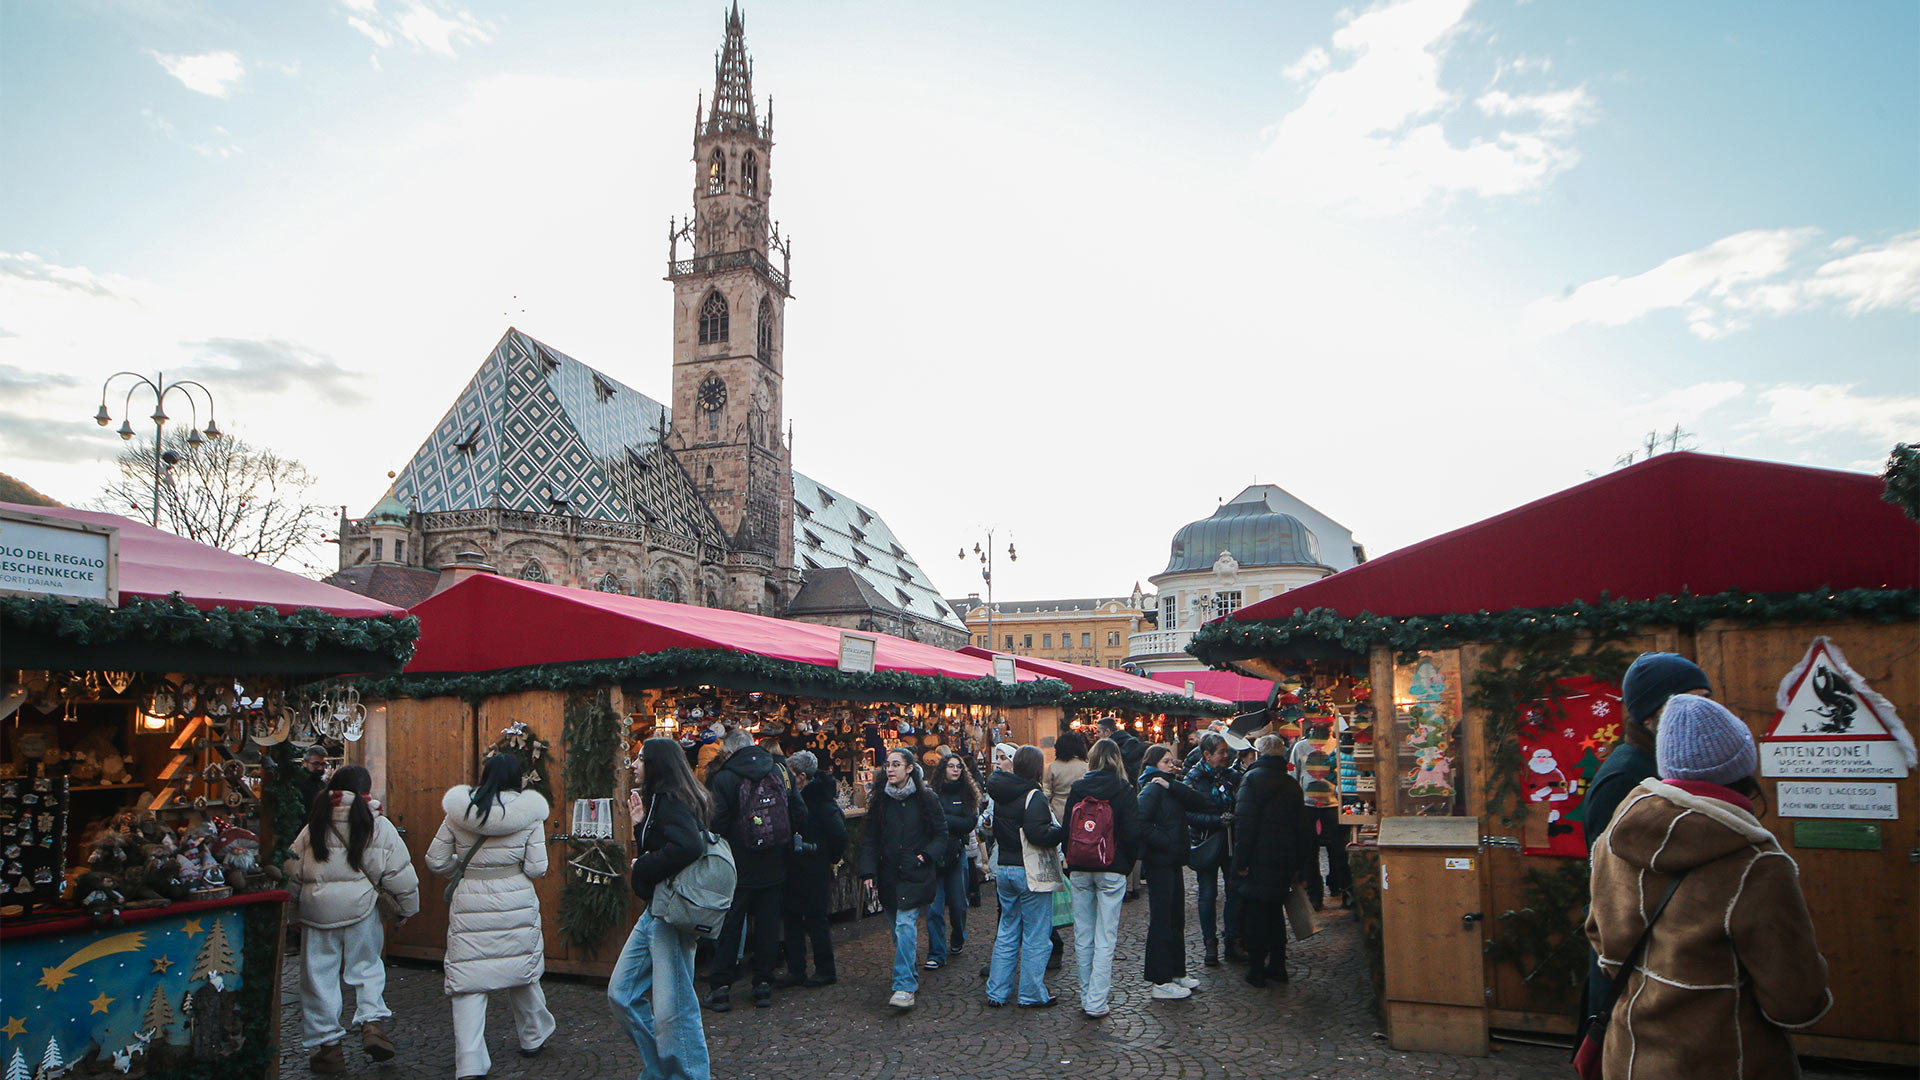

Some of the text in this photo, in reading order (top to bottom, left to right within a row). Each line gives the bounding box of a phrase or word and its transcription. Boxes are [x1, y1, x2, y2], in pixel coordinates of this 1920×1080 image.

[27, 549, 51, 562] DEL
[54, 553, 104, 569] REGALO
[0, 561, 94, 581] ESCHENKECKE
[28, 577, 64, 588] DAIANA
[1784, 786, 1822, 796] VIETATO
